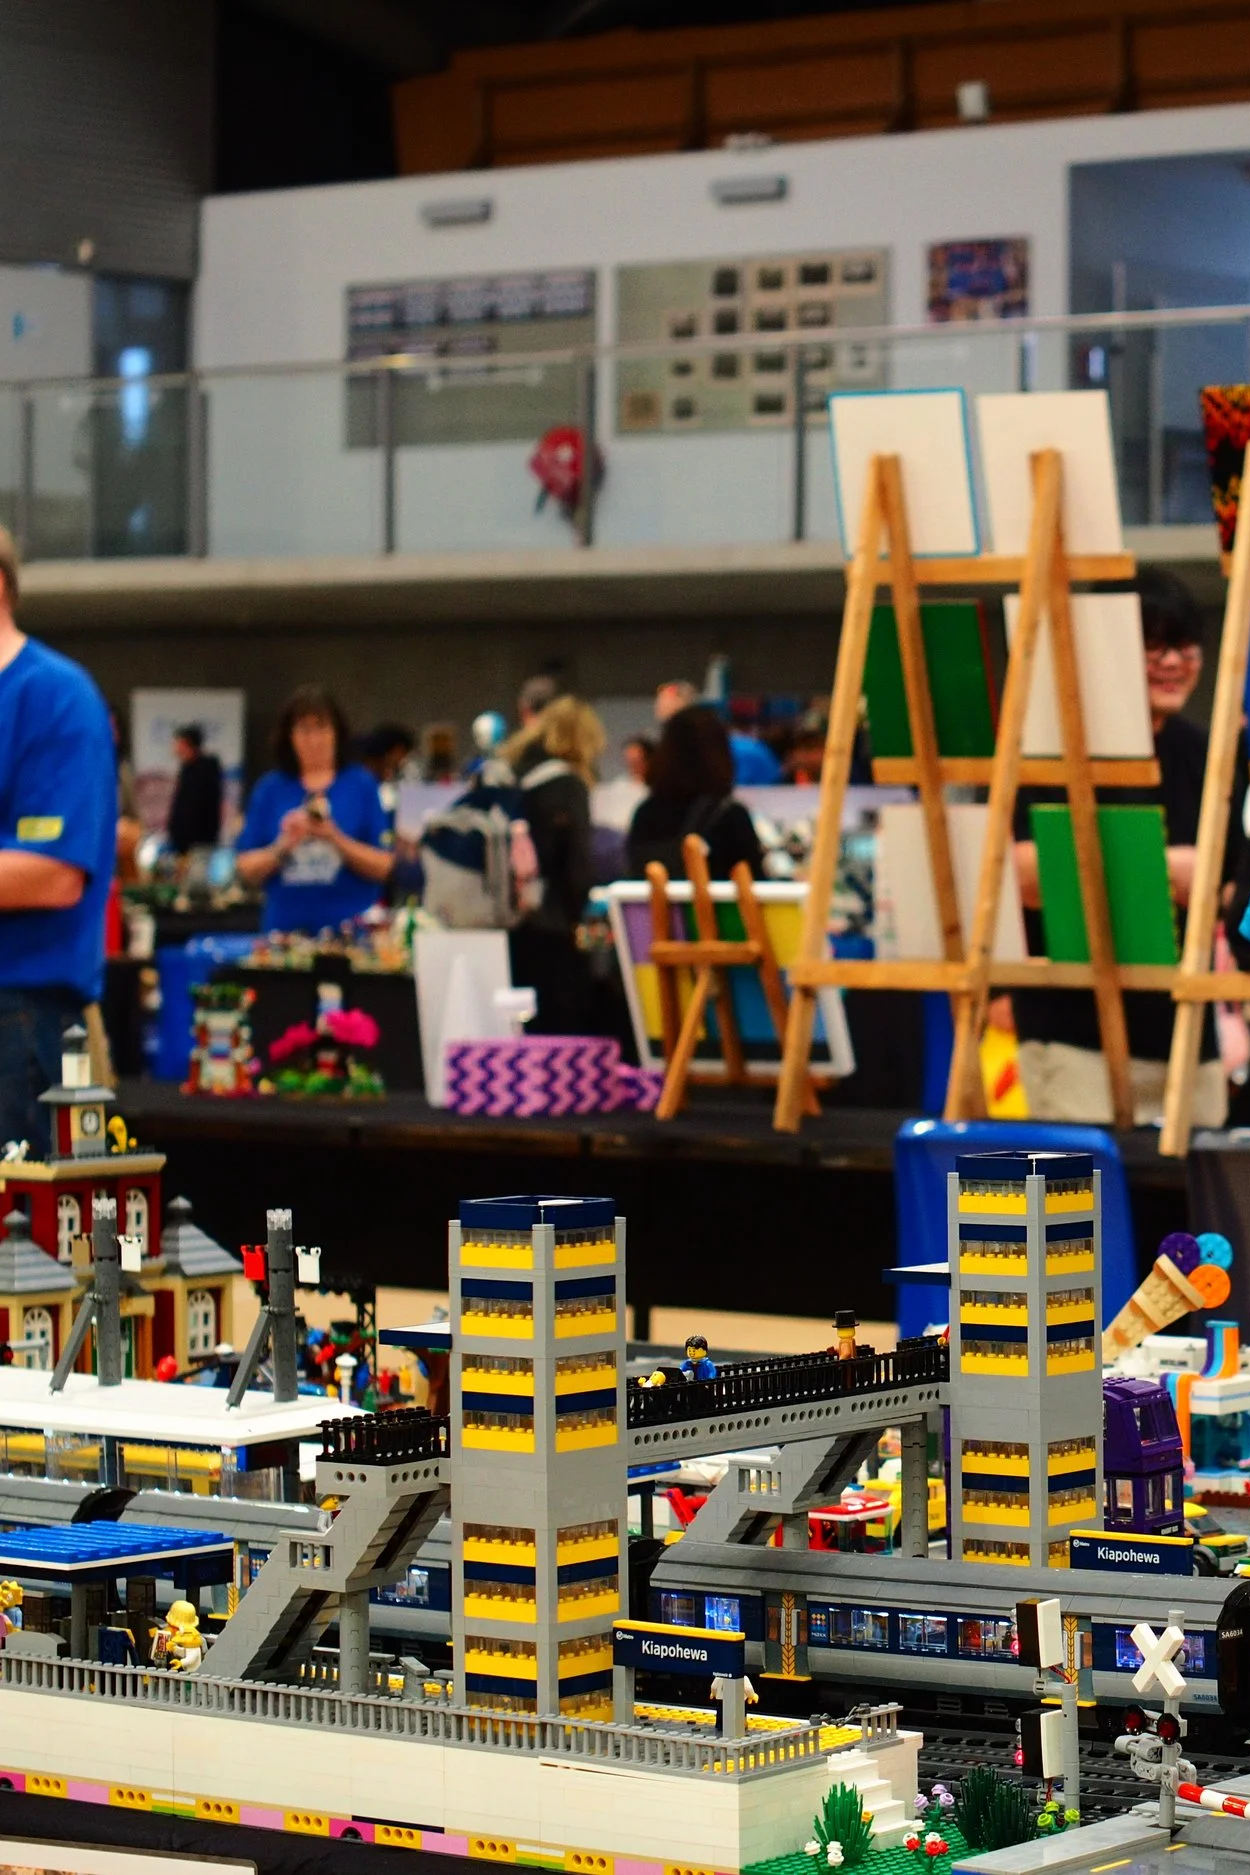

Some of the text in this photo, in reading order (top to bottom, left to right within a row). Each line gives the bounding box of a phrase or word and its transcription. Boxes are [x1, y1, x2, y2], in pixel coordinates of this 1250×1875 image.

[1097, 1546, 1160, 1564] Kiapohewa
[1221, 1628, 1243, 1639] SA6034
[641, 1640, 708, 1661] Kiapohewa
